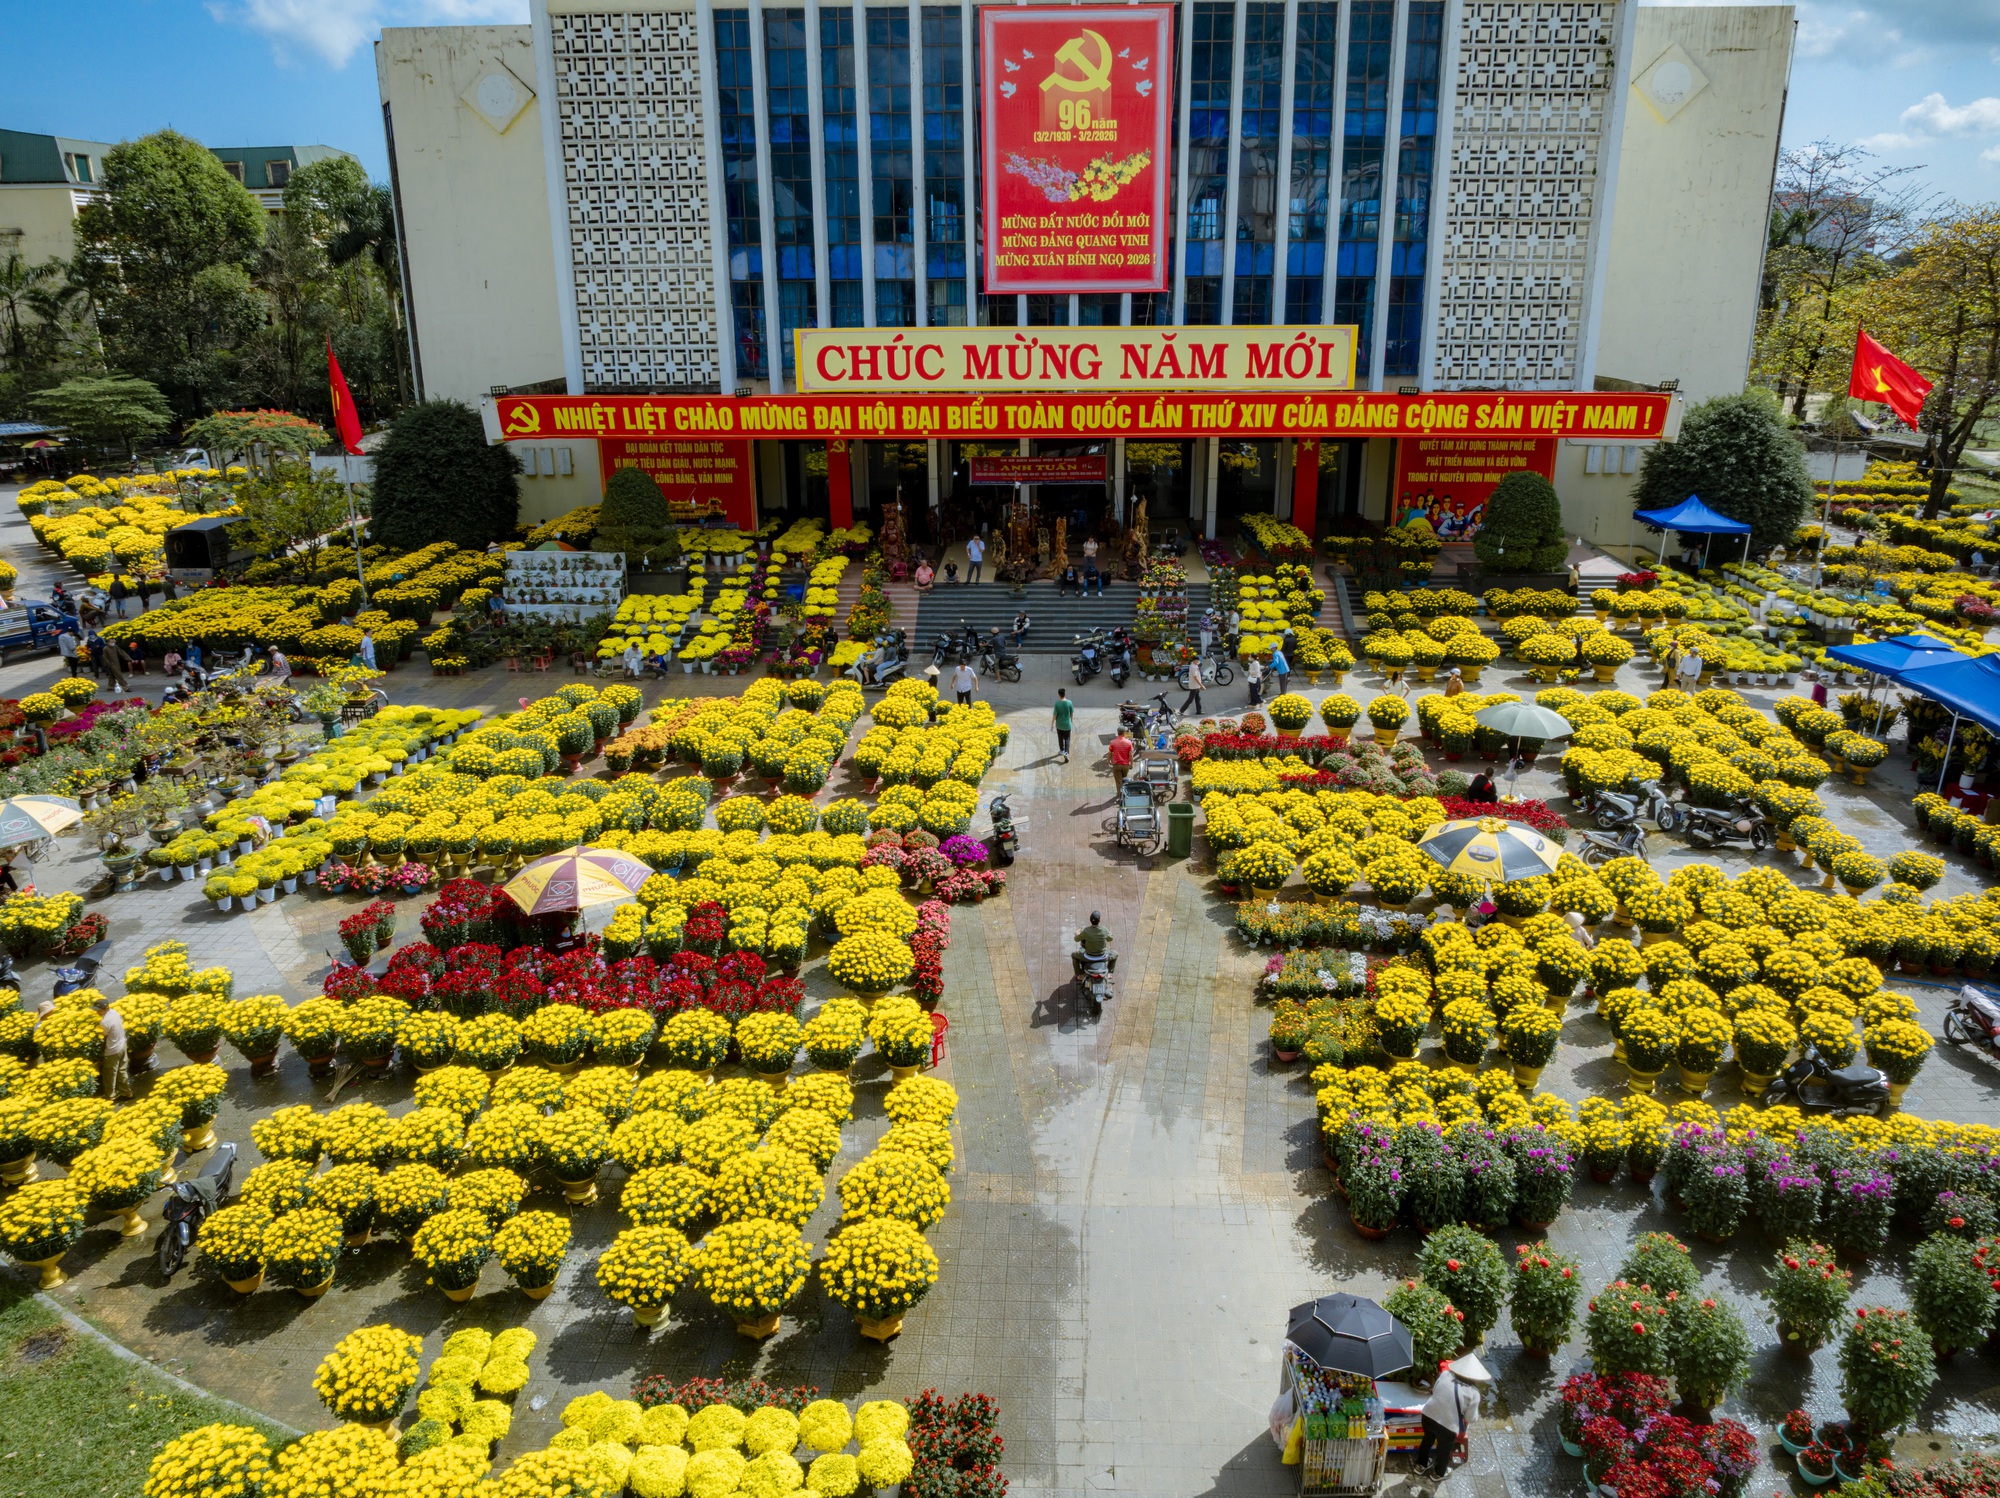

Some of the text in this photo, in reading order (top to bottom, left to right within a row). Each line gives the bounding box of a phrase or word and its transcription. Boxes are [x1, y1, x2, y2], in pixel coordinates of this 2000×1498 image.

[1058, 99, 1118, 131] 96 năm
[1033, 131, 1072, 143] (3/2/1930
[1078, 131, 1118, 143] 3/2/2026)
[1001, 210, 1150, 229] MỪNG ĐẤT NƯỚC ĐỔI MỚI
[1002, 231, 1149, 249] MỪNG ĐẢNG QUANG VINH
[995, 251, 1030, 267] MỪNG
[1032, 251, 1065, 266] XUÂN
[1067, 251, 1096, 266] BÍNH
[1099, 253, 1124, 268] NGỌ
[1127, 253, 1150, 265] 2026
[816, 331, 1335, 382] CHÚC MỪNG NĂM MỚI
[553, 396, 1653, 437] NHIỆT LIỆT CHÀO MỪNG ĐẠI HỘI ĐẠI BIỂU TOÀN QUỐC LẦN THỨ XIV CỦA ĐẢNG CỘNG SẢN VIỆT NAM !
[625, 439, 724, 455] ĐẠI ĐOÀN KẾT TOÀN DÂN TỘC
[1419, 438, 1537, 452] QUYẾT TÂM XÂY DỰNG THÀNH PHỐ HUẾ
[640, 455, 656, 469] TIÊU
[656, 456, 672, 469] DÂN
[672, 456, 692, 470] GIÀU,
[692, 455, 713, 469] NƯỚC
[714, 457, 739, 471] MẠNH,
[1000, 462, 1078, 472] ANH TUẤN
[1426, 454, 1443, 467] PHÁT
[1463, 456, 1486, 467] NHANH
[1486, 454, 1496, 467] VÀ
[654, 471, 675, 484] CÔNG
[697, 471, 713, 484] VĂN
[714, 473, 733, 484] MINH
[1407, 472, 1429, 483] TRONG
[1439, 470, 1465, 483] NGUYÊN
